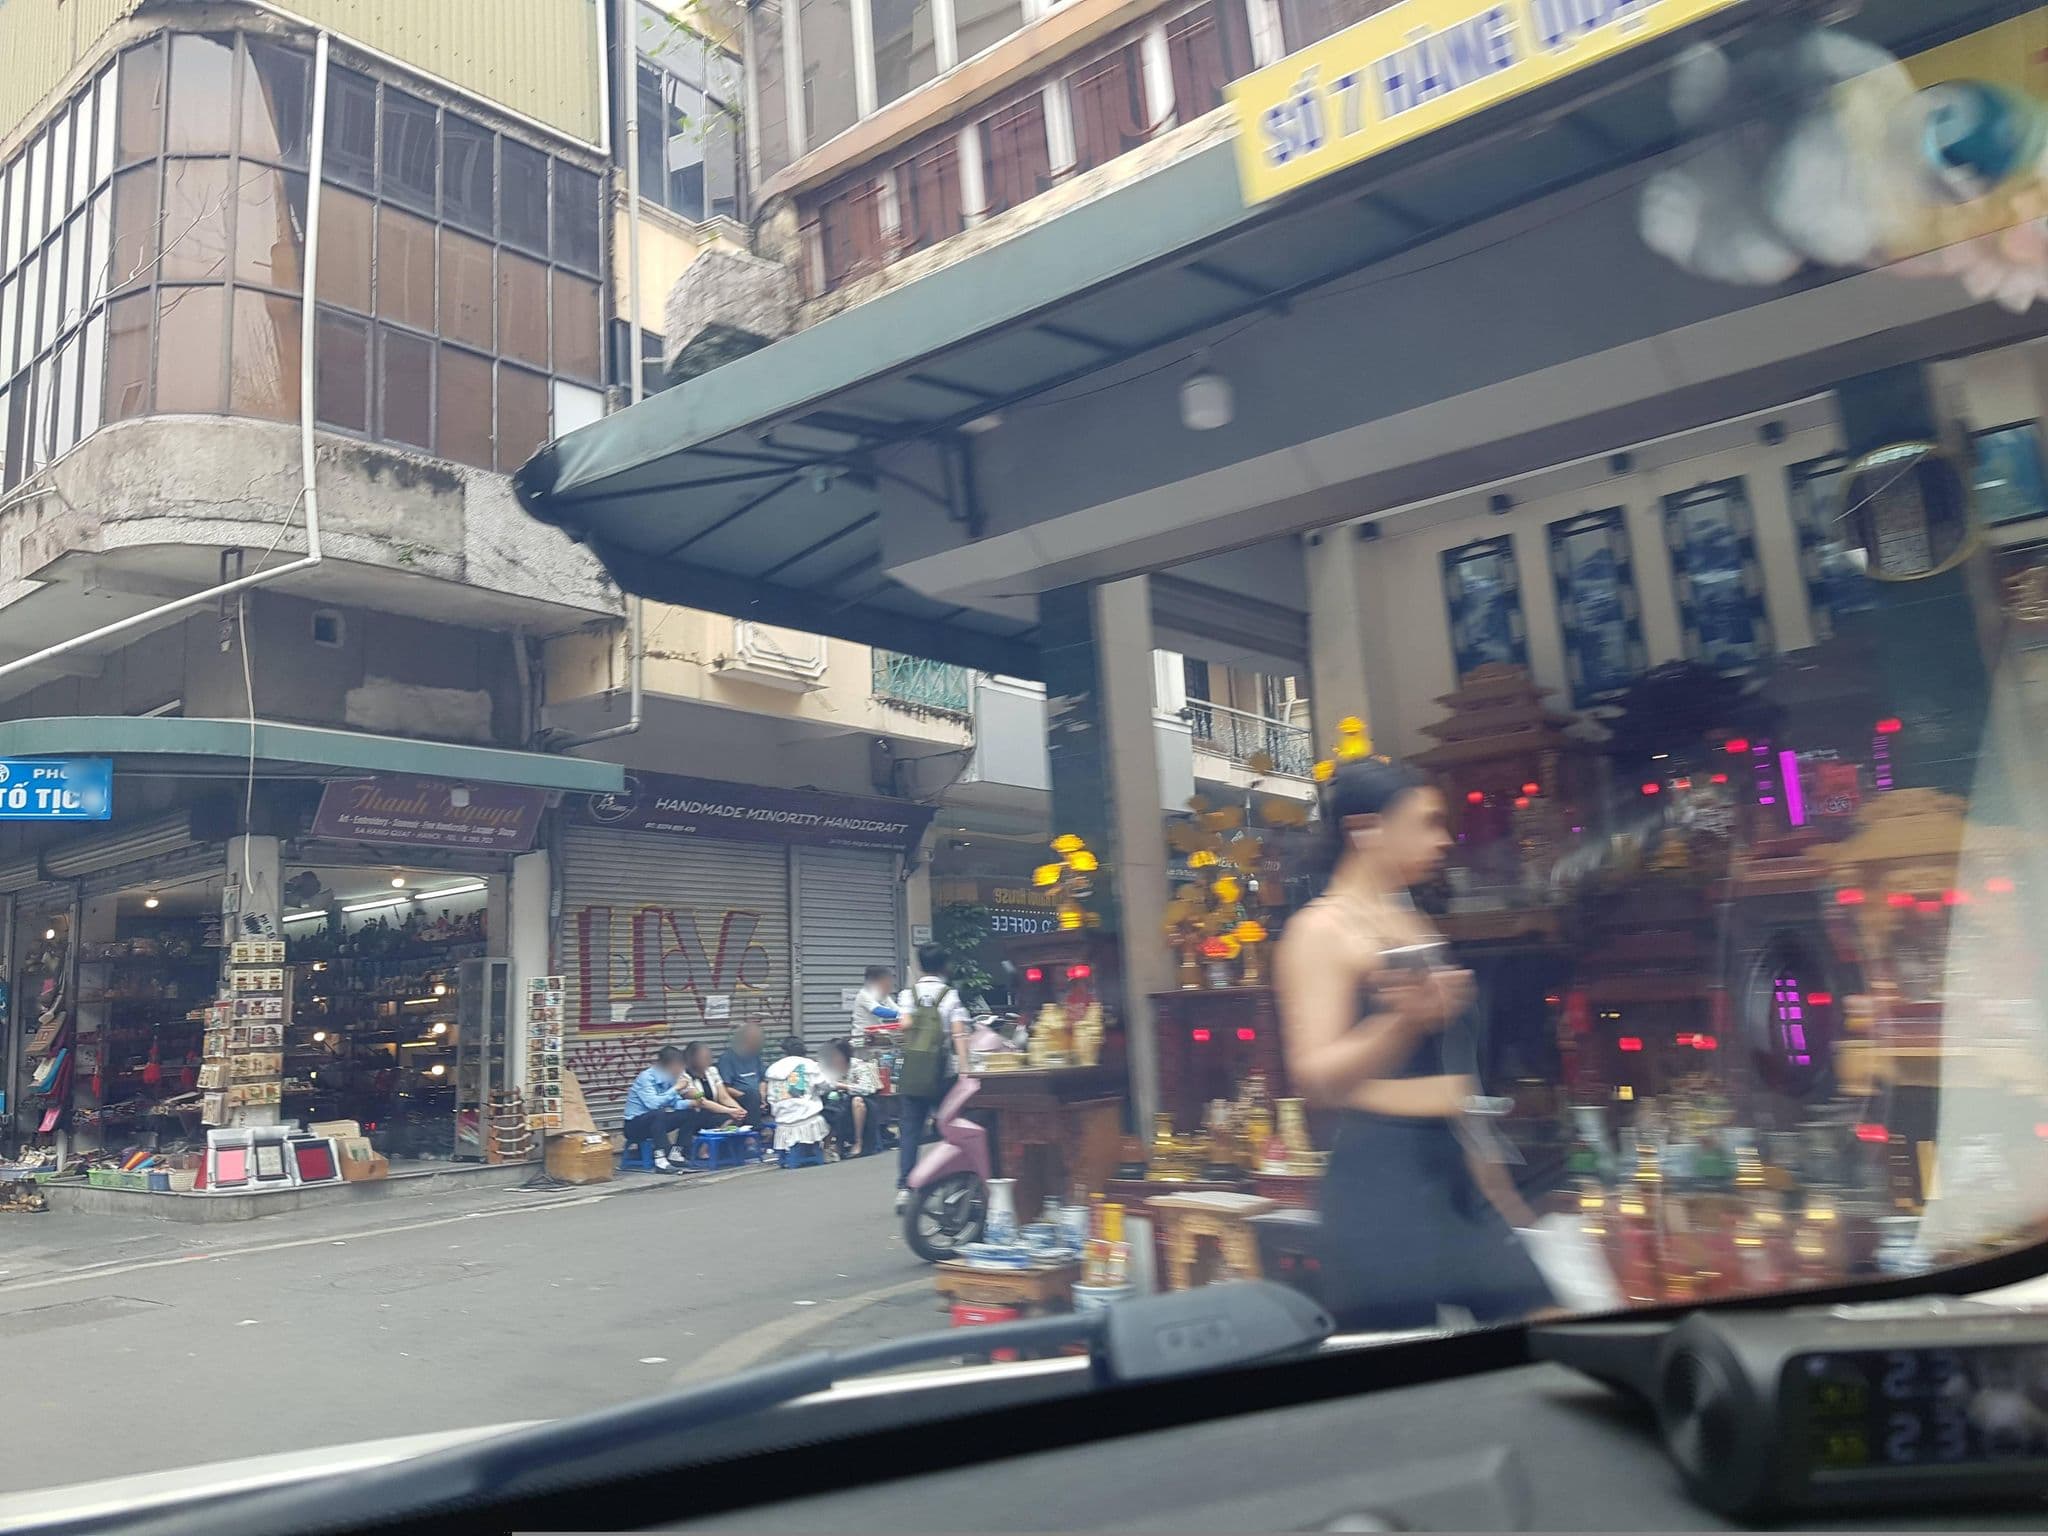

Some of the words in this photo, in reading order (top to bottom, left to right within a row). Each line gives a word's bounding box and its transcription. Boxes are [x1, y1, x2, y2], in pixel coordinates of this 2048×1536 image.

[1327, 70, 1367, 138] 7
[35, 788, 88, 814] TỊC
[655, 798, 745, 818] HANDMADE
[746, 808, 824, 826] MINORITY
[822, 817, 908, 834] HANDICRAFT
